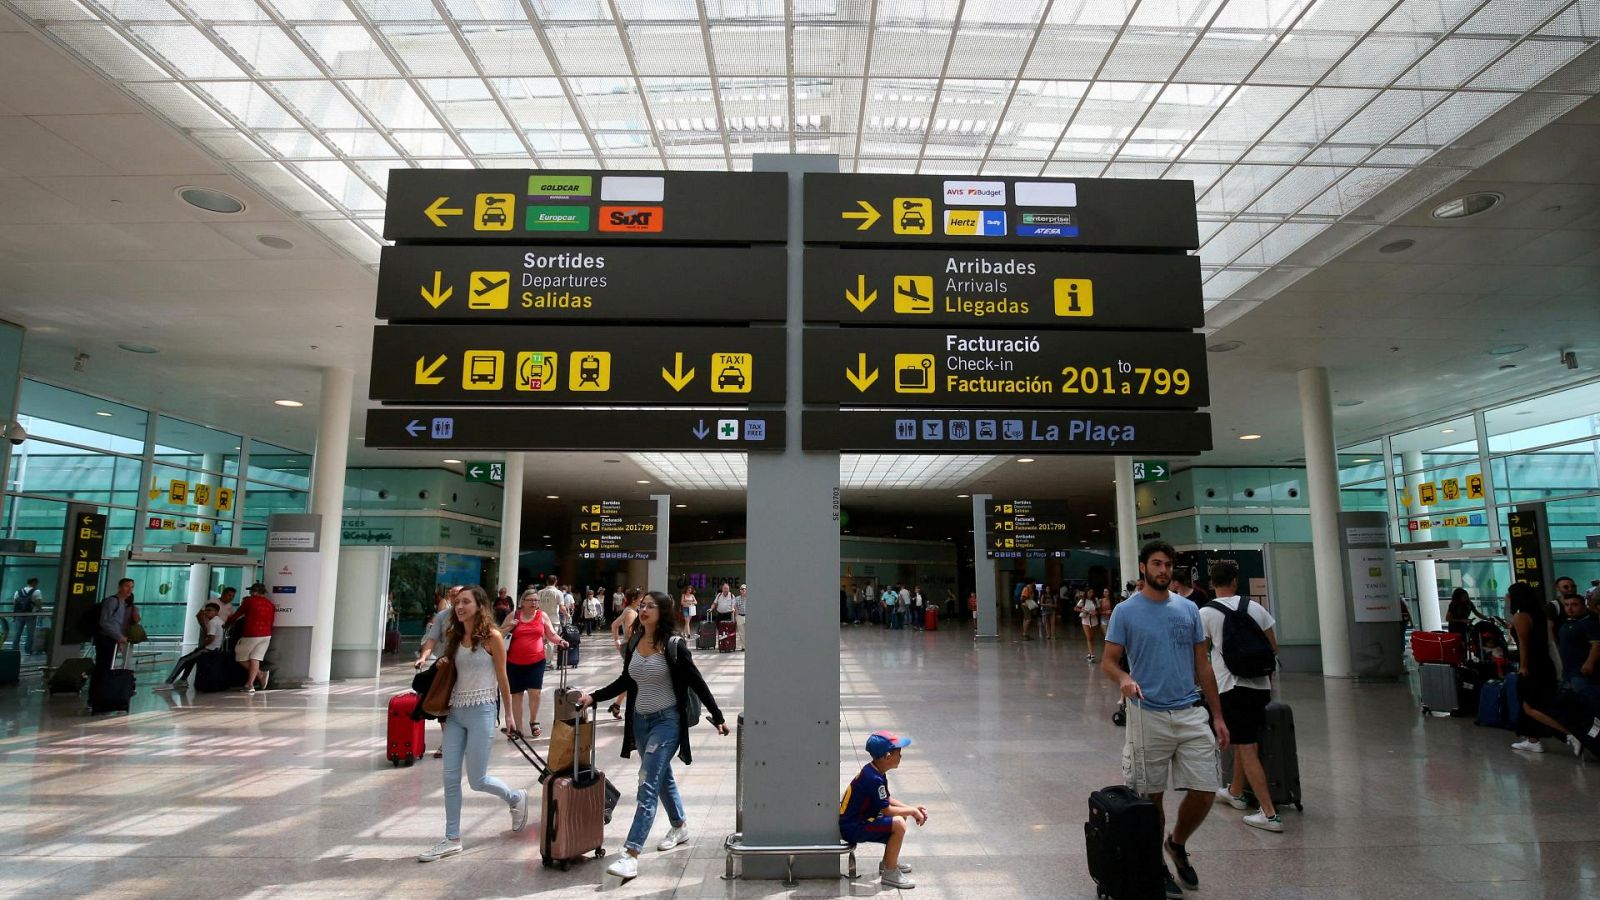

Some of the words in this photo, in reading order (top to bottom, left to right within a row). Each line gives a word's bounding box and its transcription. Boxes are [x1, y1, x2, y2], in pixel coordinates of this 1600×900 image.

[539, 214, 576, 222] Europcar
[950, 218, 975, 226] Hertz
[524, 252, 605, 268] Sortides
[946, 258, 1036, 274] Arribades
[522, 273, 607, 289] Departures
[946, 278, 1007, 293] Arrivals
[522, 292, 592, 308] Salidas
[946, 297, 1029, 316] Llegadas
[947, 336, 1040, 352] Facturació
[720, 356, 744, 364] TAXI
[947, 356, 1013, 371] Check-in
[1118, 360, 1131, 373] to
[947, 376, 1052, 393] Facturación
[1062, 367, 1115, 394] 201
[1121, 382, 1131, 394] a
[1135, 368, 1190, 394] 799
[1031, 420, 1058, 440] La
[1069, 420, 1135, 446] Plaça
[833, 512, 839, 520] SE
